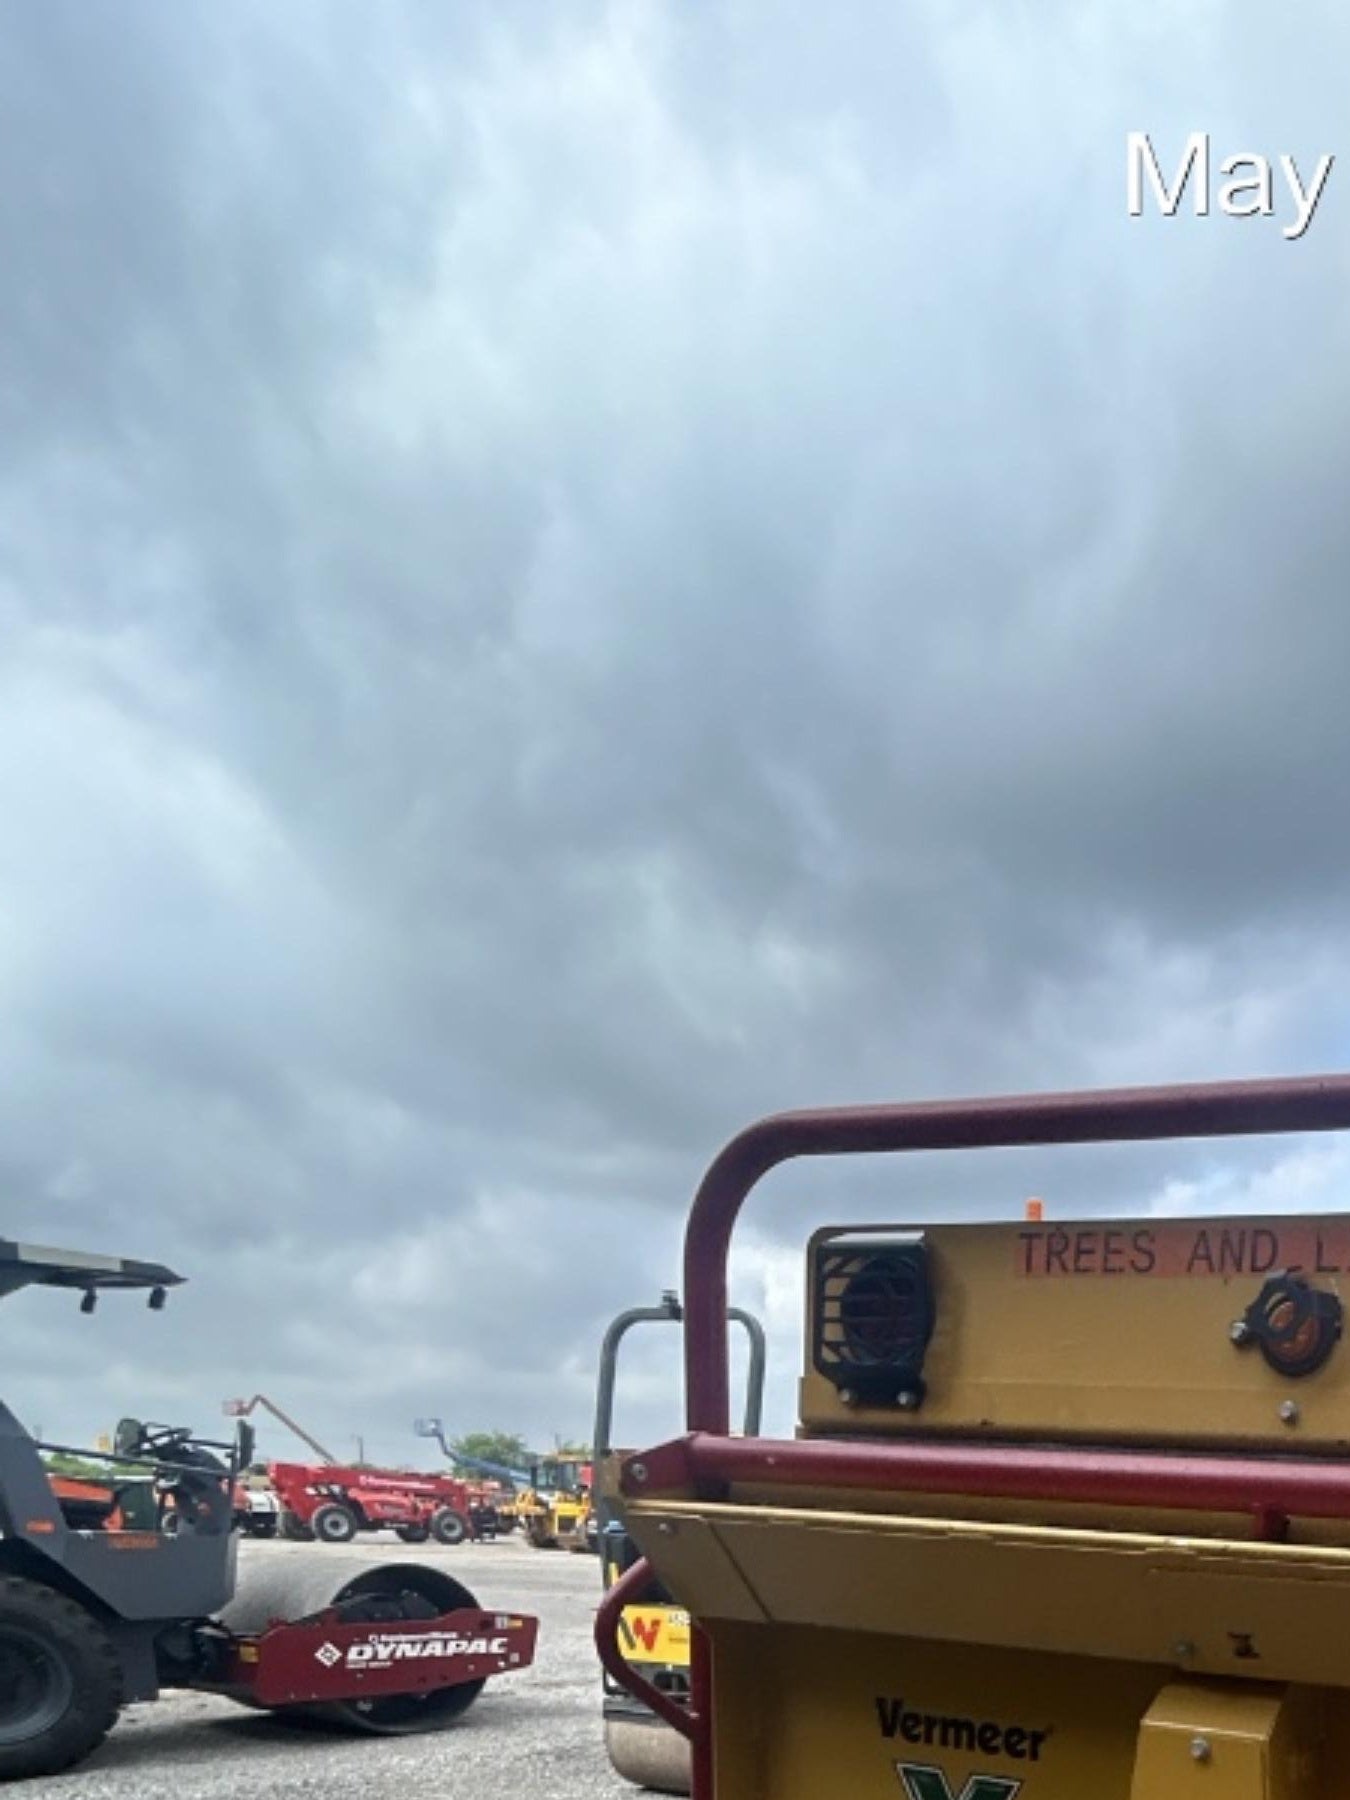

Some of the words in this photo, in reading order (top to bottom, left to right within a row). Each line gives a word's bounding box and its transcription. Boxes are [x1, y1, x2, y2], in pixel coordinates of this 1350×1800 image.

[1019, 1228, 1156, 1273] TREES
[1187, 1228, 1279, 1273] AND
[347, 1637, 508, 1661] DYNAPAC
[876, 1697, 1046, 1761] Vermeer
